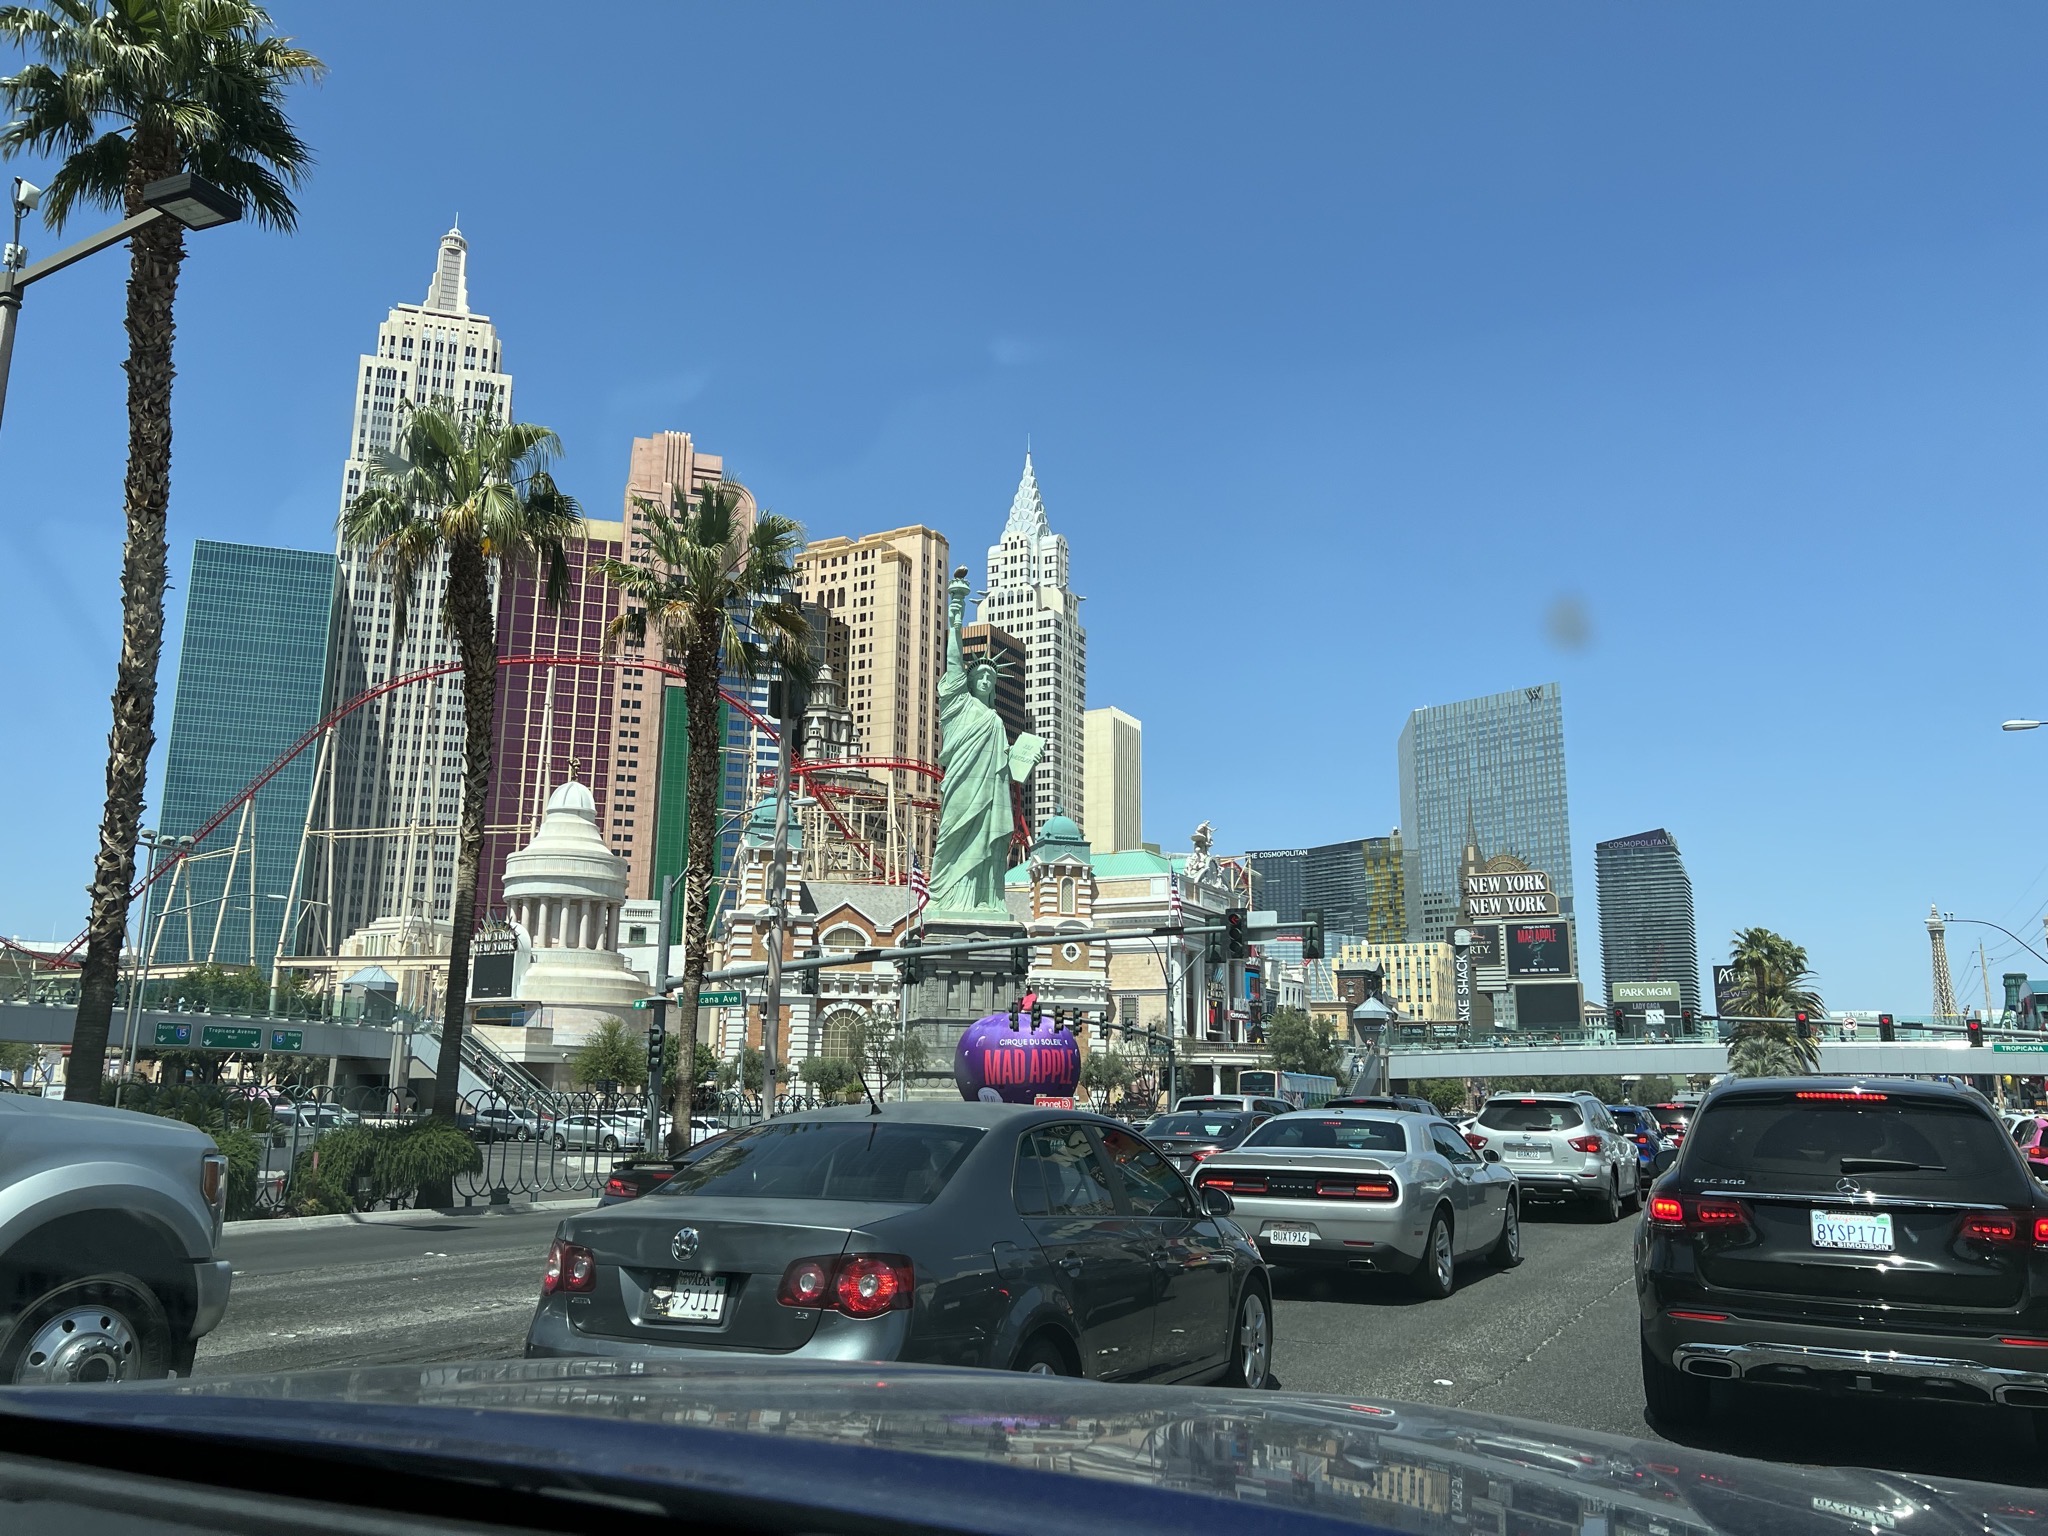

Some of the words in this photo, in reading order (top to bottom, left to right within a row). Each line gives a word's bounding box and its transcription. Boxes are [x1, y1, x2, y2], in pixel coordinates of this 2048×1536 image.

[1608, 838, 1668, 849] COSMOPOLITAN
[1259, 850, 1308, 859] COSMOPOLITAN
[1468, 876, 1501, 894] NEW
[1504, 873, 1546, 893] YORK
[1469, 897, 1502, 915] NEW
[1505, 895, 1547, 913] YORK
[493, 931, 516, 940] YORK
[1517, 929, 1534, 943] MAD
[1535, 928, 1557, 943] APPLE
[493, 942, 515, 951] YORK
[1455, 954, 1469, 995] SHACK
[1619, 987, 1645, 997] PARK
[1646, 987, 1672, 996] MGM
[722, 995, 738, 1003] Ave
[1632, 1002, 1646, 1010] LADY
[1646, 1001, 1661, 1010] GAGA
[179, 1028, 187, 1037] 15
[276, 1034, 283, 1043] 15
[999, 1038, 1028, 1047] CIRQUE
[1040, 1038, 1063, 1046] SOLEIL
[984, 1049, 1025, 1085] MAD
[1029, 1048, 1074, 1085] APPLE
[1817, 1223, 1887, 1244] 8YSP177
[1839, 1241, 1889, 1251] SIMONSON
